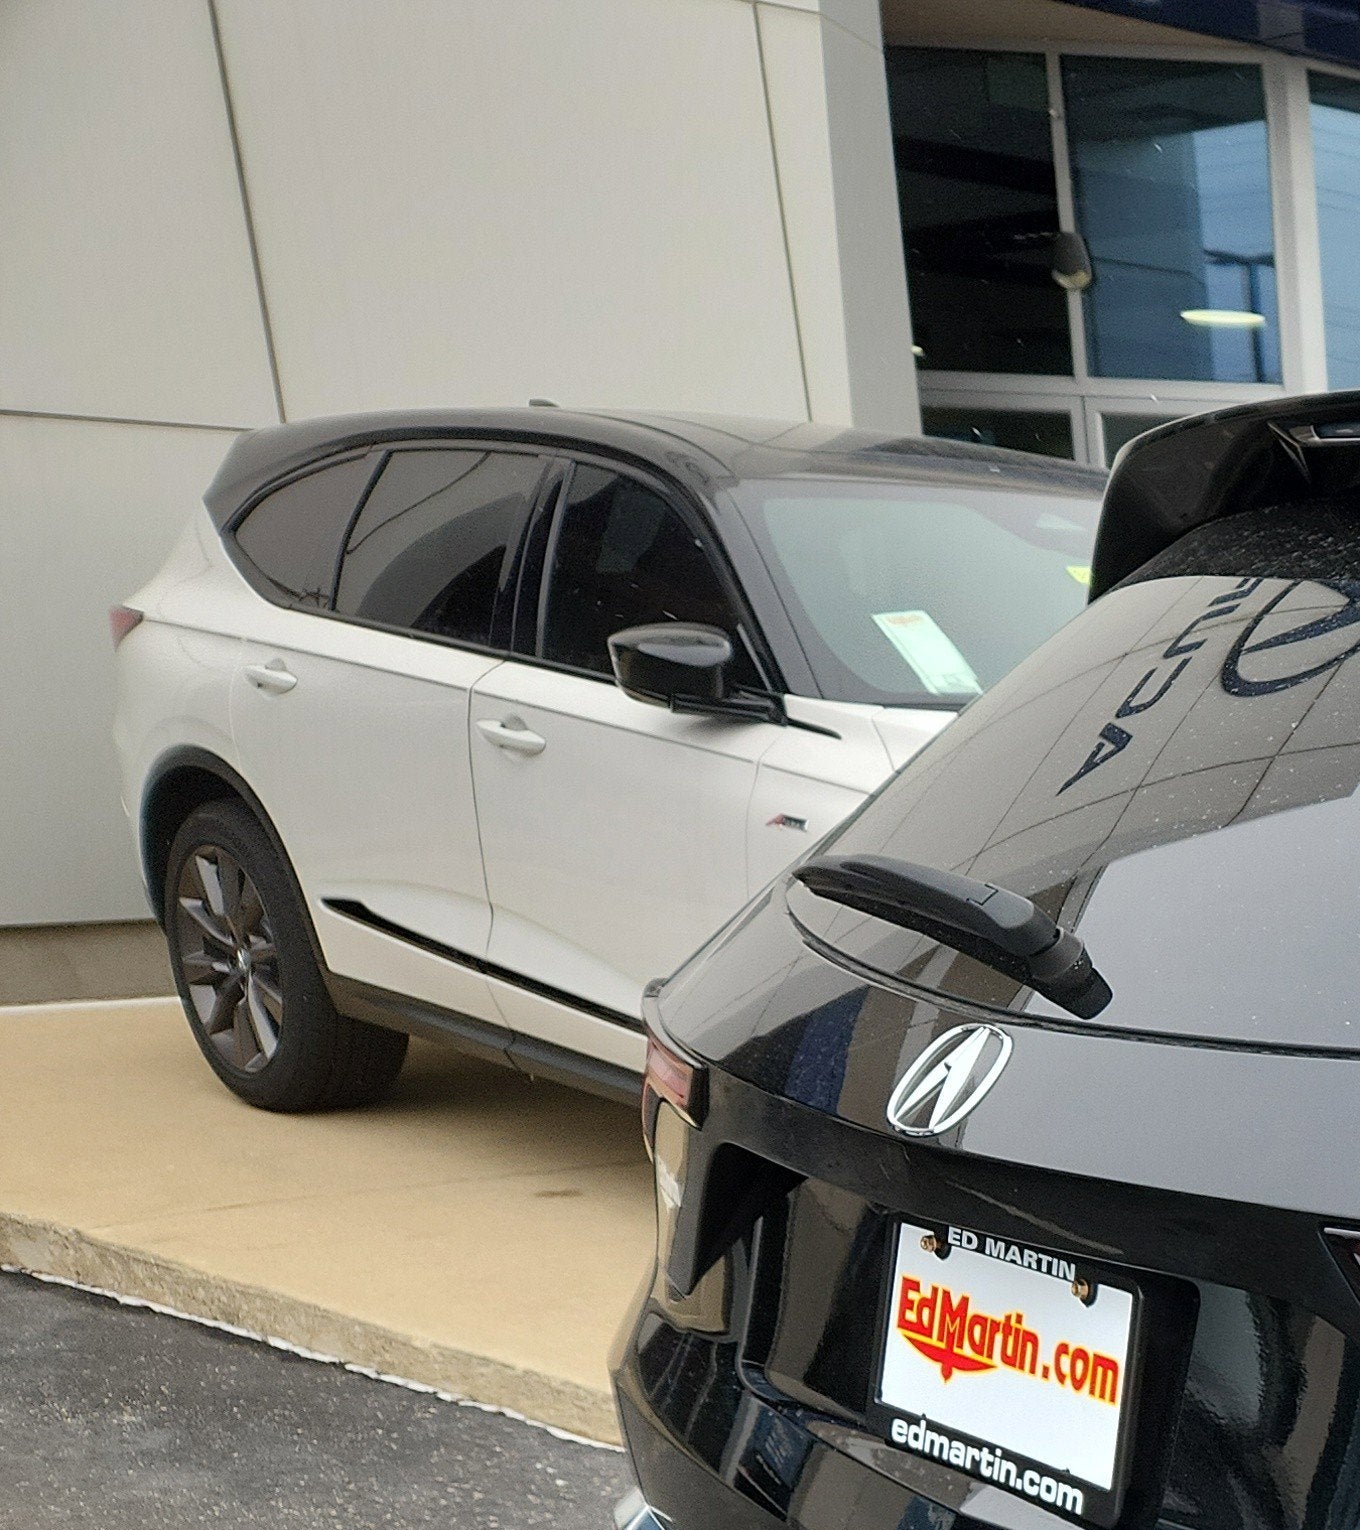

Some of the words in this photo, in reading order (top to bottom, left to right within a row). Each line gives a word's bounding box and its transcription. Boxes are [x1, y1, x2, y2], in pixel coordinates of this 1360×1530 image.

[947, 1225, 978, 1250] ED
[985, 1238, 1076, 1281] MARTIN
[897, 1275, 1121, 1406] EdMartin.com
[891, 1418, 1084, 1515] edmartin.com
